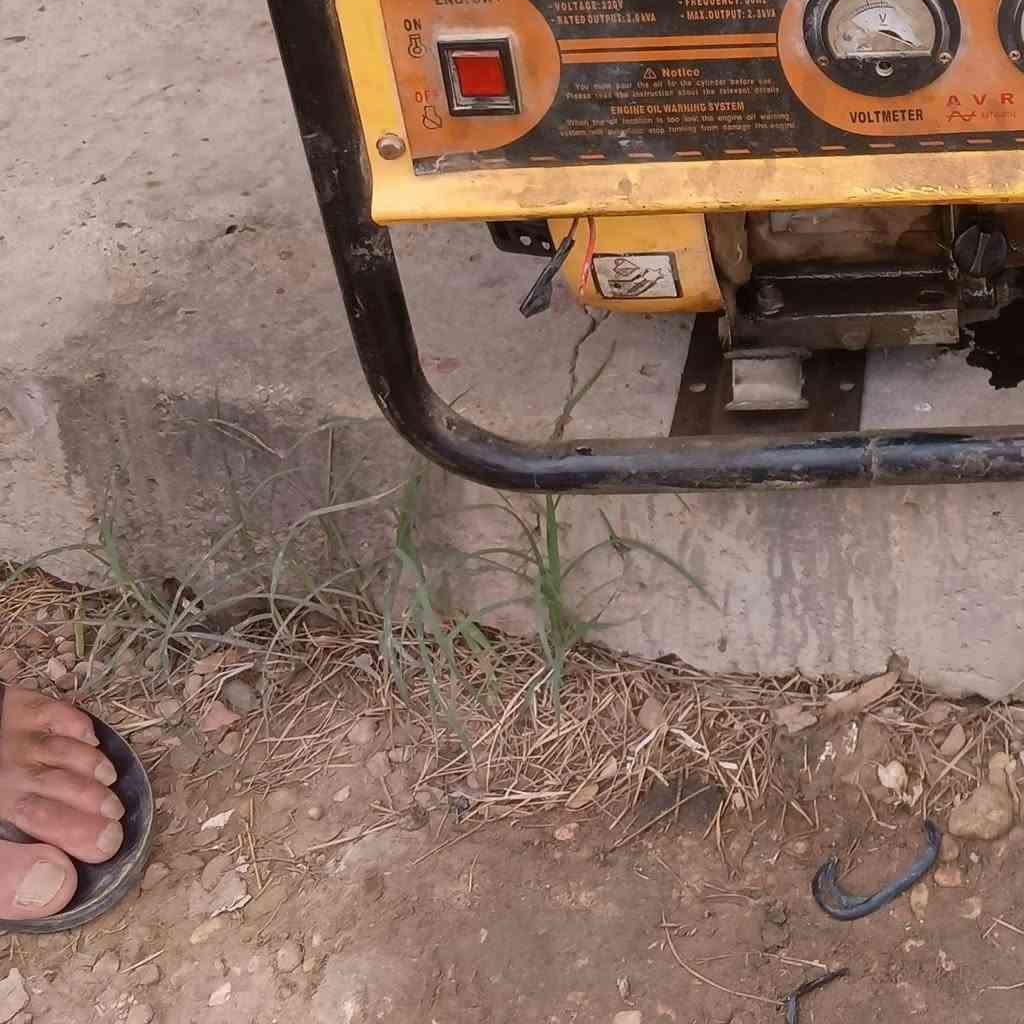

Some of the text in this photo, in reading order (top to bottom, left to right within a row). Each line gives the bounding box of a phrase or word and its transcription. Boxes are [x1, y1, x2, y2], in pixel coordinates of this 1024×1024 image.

[403, 18, 422, 32] ON
[646, 103, 662, 114] OIL
[848, 108, 924, 124] VOLTMETER
